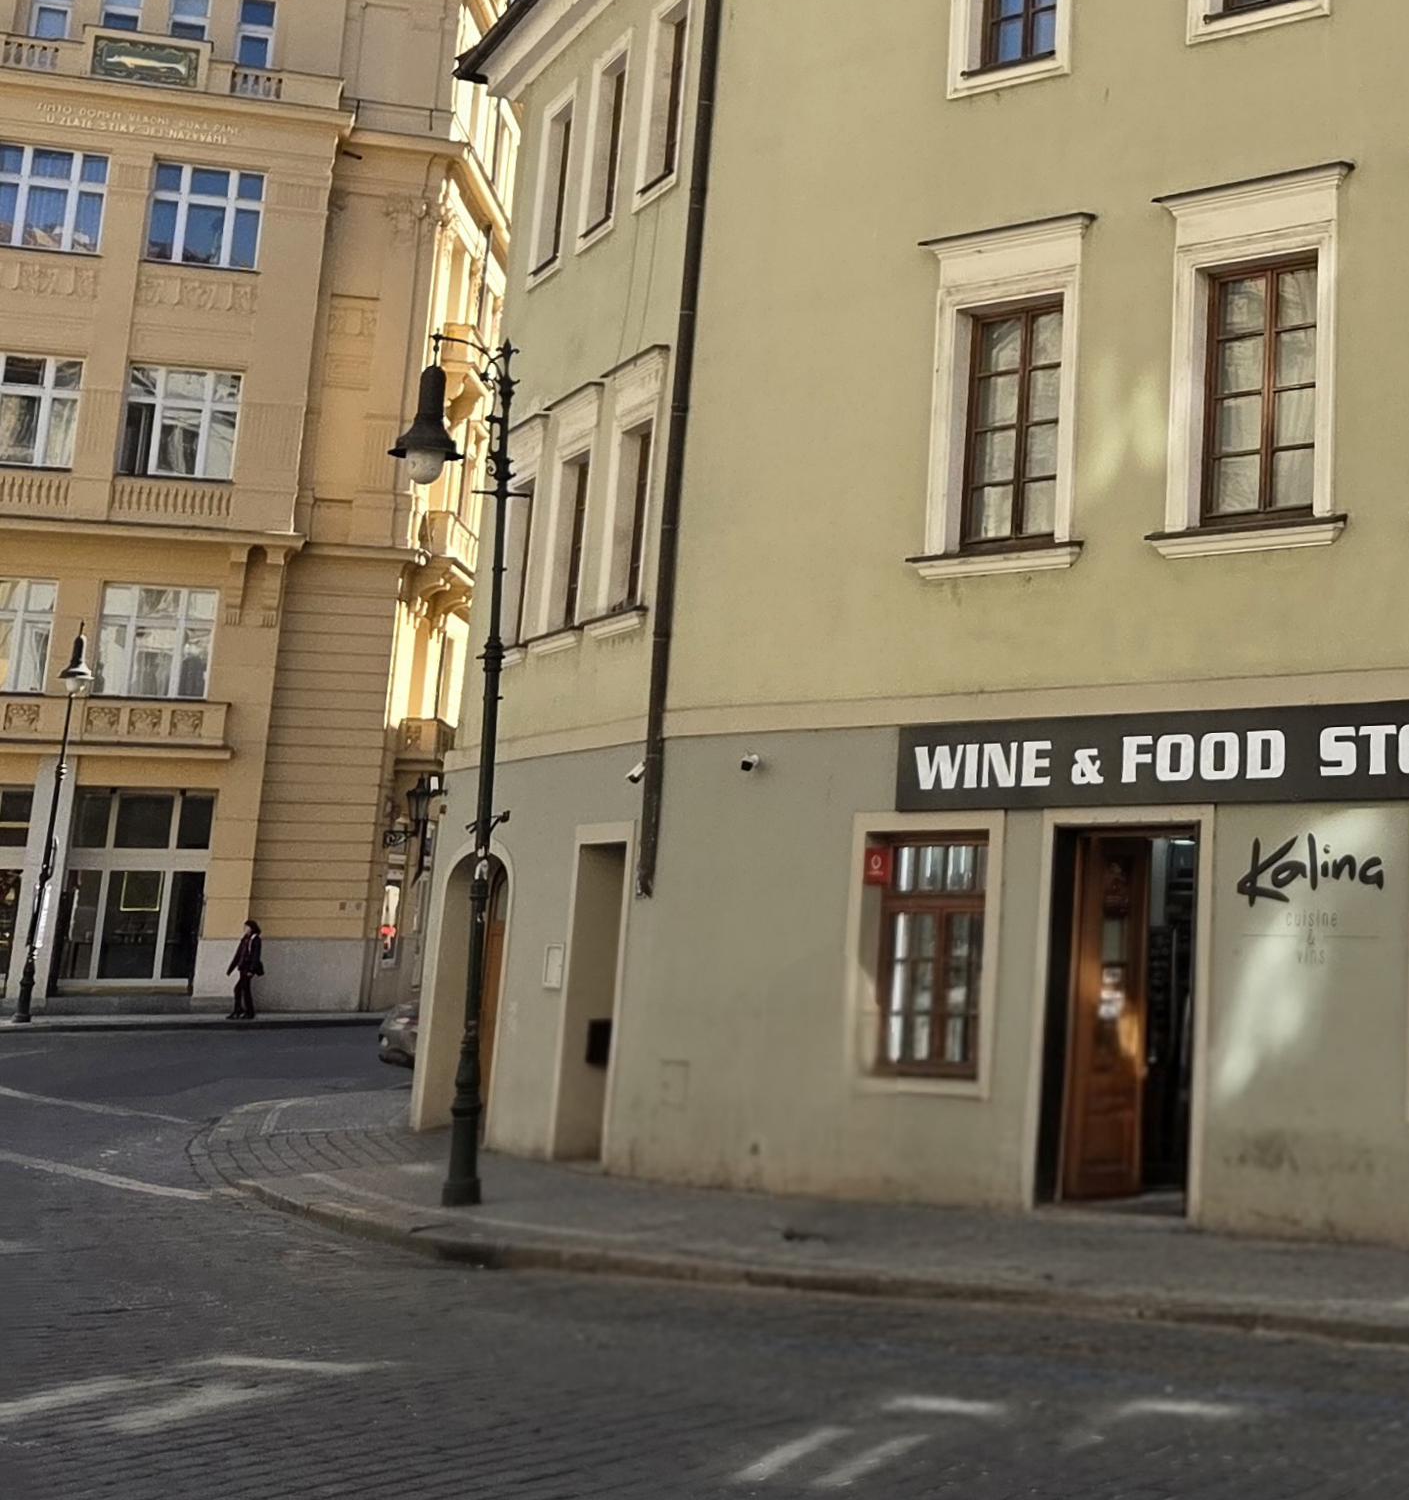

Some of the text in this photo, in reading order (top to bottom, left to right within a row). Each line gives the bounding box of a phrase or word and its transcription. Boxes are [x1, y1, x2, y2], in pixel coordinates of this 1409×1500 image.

[914, 740, 1052, 790] WINE
[1071, 748, 1104, 785] &
[1121, 729, 1286, 784] FOOD
[1237, 832, 1384, 908] Kalina
[1286, 909, 1338, 928] cuisine
